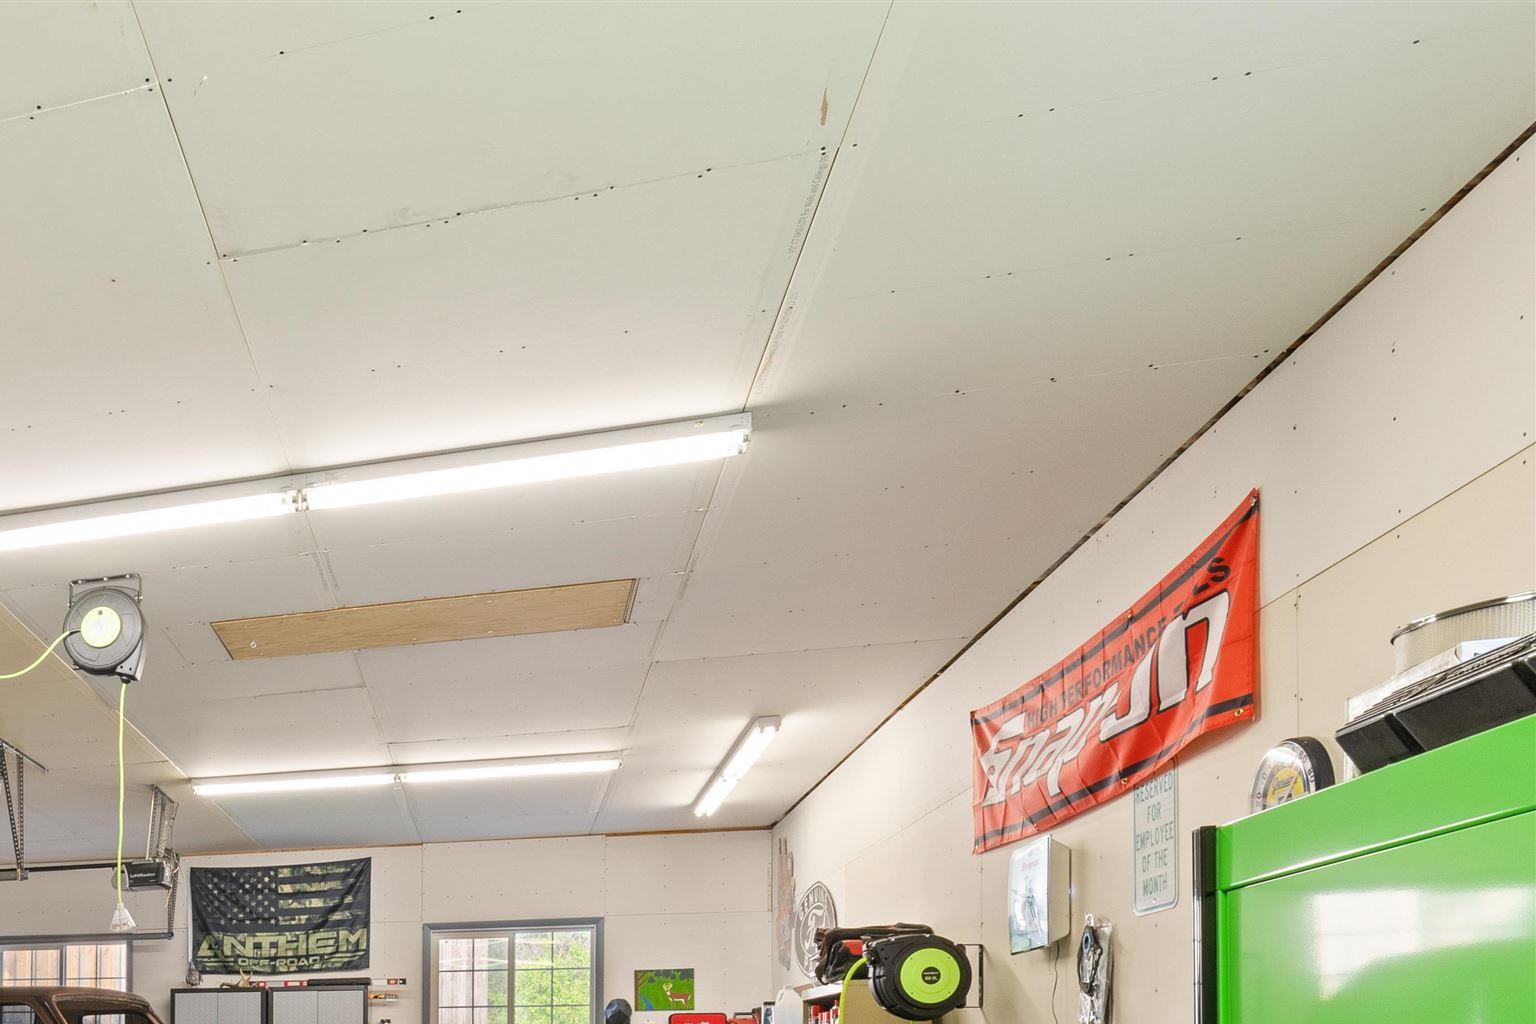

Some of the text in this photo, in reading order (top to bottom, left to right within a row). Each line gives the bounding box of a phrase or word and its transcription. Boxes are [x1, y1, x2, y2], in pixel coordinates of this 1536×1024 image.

[1135, 773, 1173, 803] RESERVED
[1147, 802, 1162, 824] FOR
[1136, 821, 1174, 851] EMPLOYEE
[1142, 848, 1168, 873] OF THE
[1143, 873, 1168, 897] MONTH
[197, 928, 367, 957] ANTHEM
[238, 955, 321, 967] OFF-ROAD
